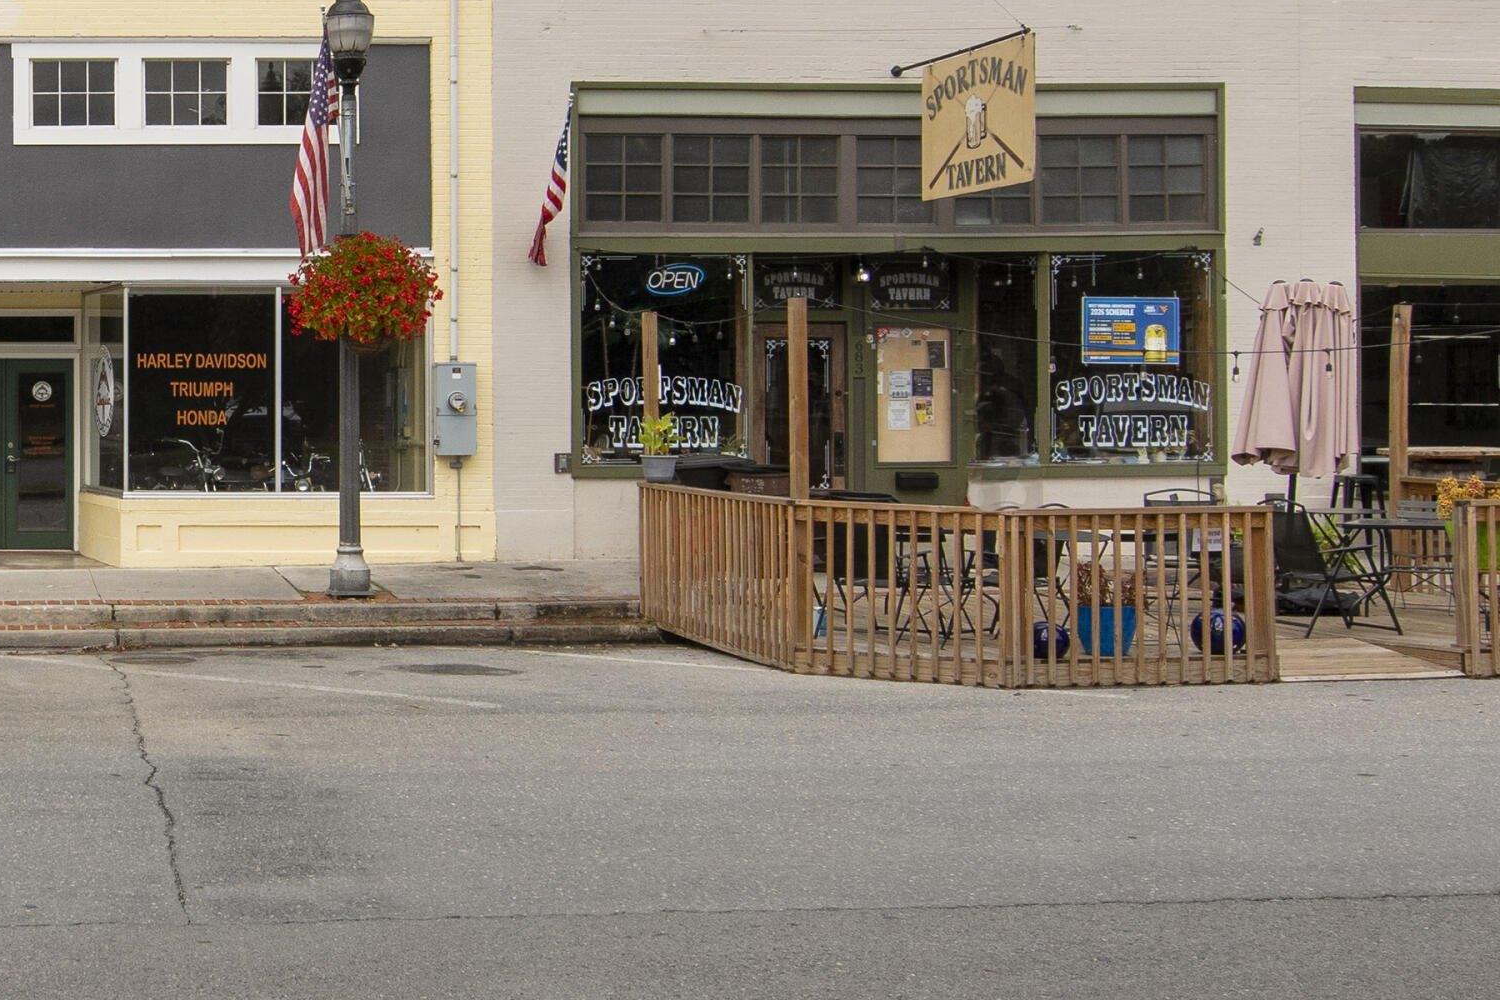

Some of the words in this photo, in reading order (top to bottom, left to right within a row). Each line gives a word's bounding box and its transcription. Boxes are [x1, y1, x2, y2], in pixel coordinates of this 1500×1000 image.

[925, 56, 1028, 121] SPORTSMAN
[946, 152, 1007, 190] TAVERN
[648, 270, 699, 289] OPEN
[879, 273, 940, 288] SPORTSMAN
[888, 287, 931, 300] TAVERN
[137, 353, 192, 369] HARLEY
[195, 353, 267, 369] DAVIDSON
[170, 382, 234, 397] TRIUMPH
[1055, 373, 1210, 411] SPORTSMAN
[176, 410, 228, 426] HONDA
[1078, 414, 1188, 447] TAVERN
